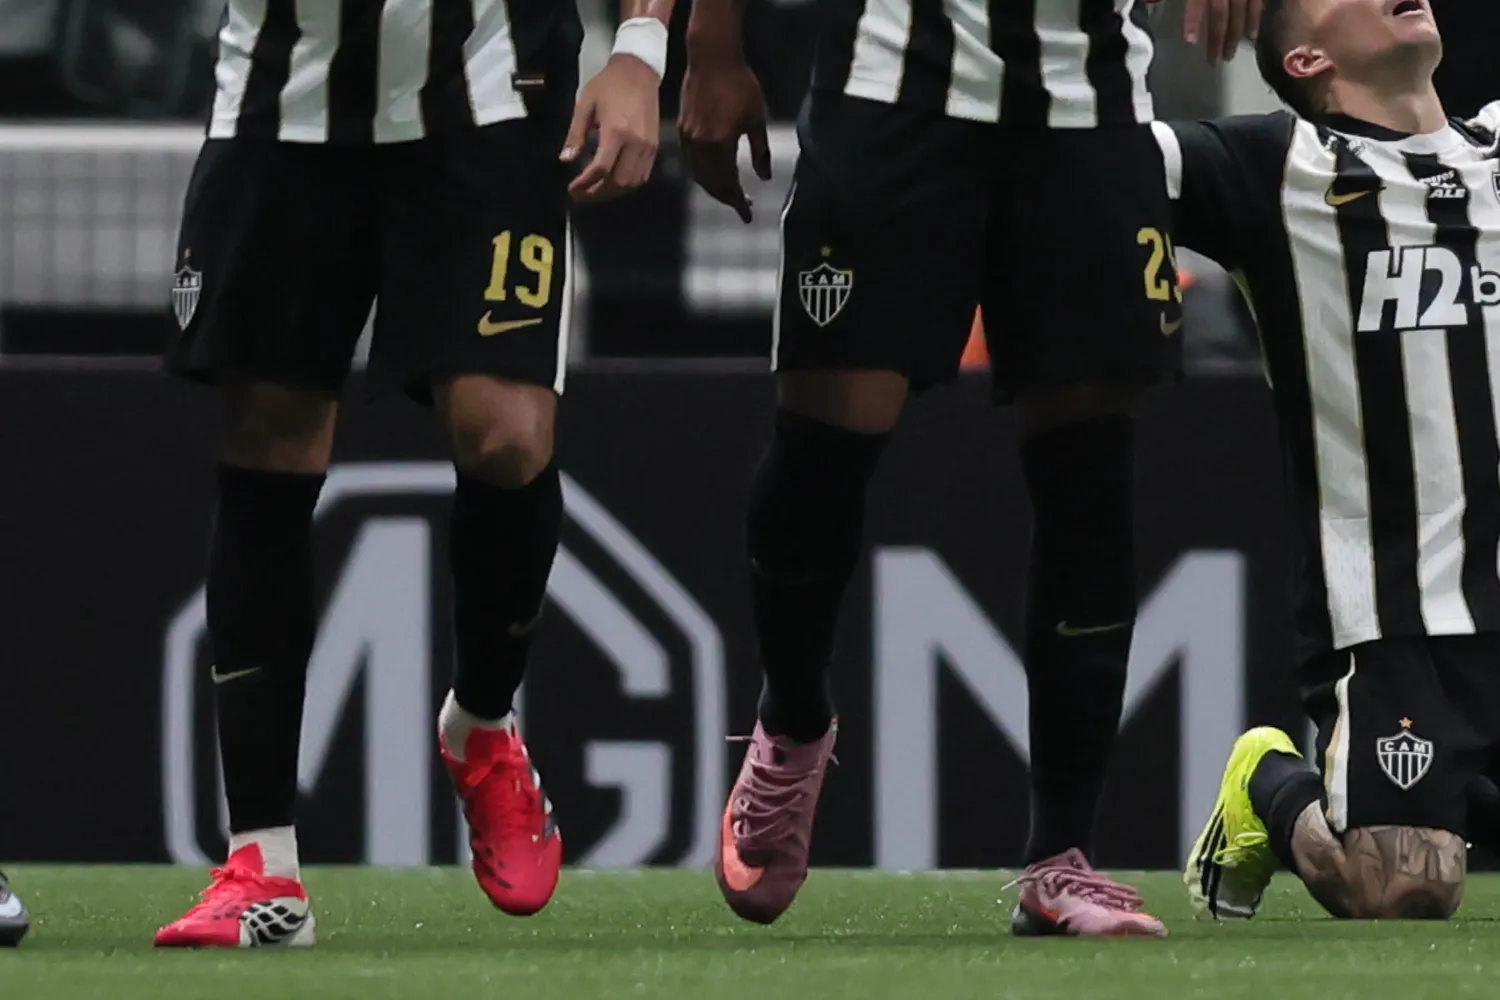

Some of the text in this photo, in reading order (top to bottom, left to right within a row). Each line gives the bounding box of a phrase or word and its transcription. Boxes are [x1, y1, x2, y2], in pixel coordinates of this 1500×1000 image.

[1430, 188, 1466, 199] ALE
[484, 229, 554, 308] 19
[1136, 226, 1183, 304] 2
[805, 273, 846, 286] CAM
[1384, 741, 1426, 753] CAM
